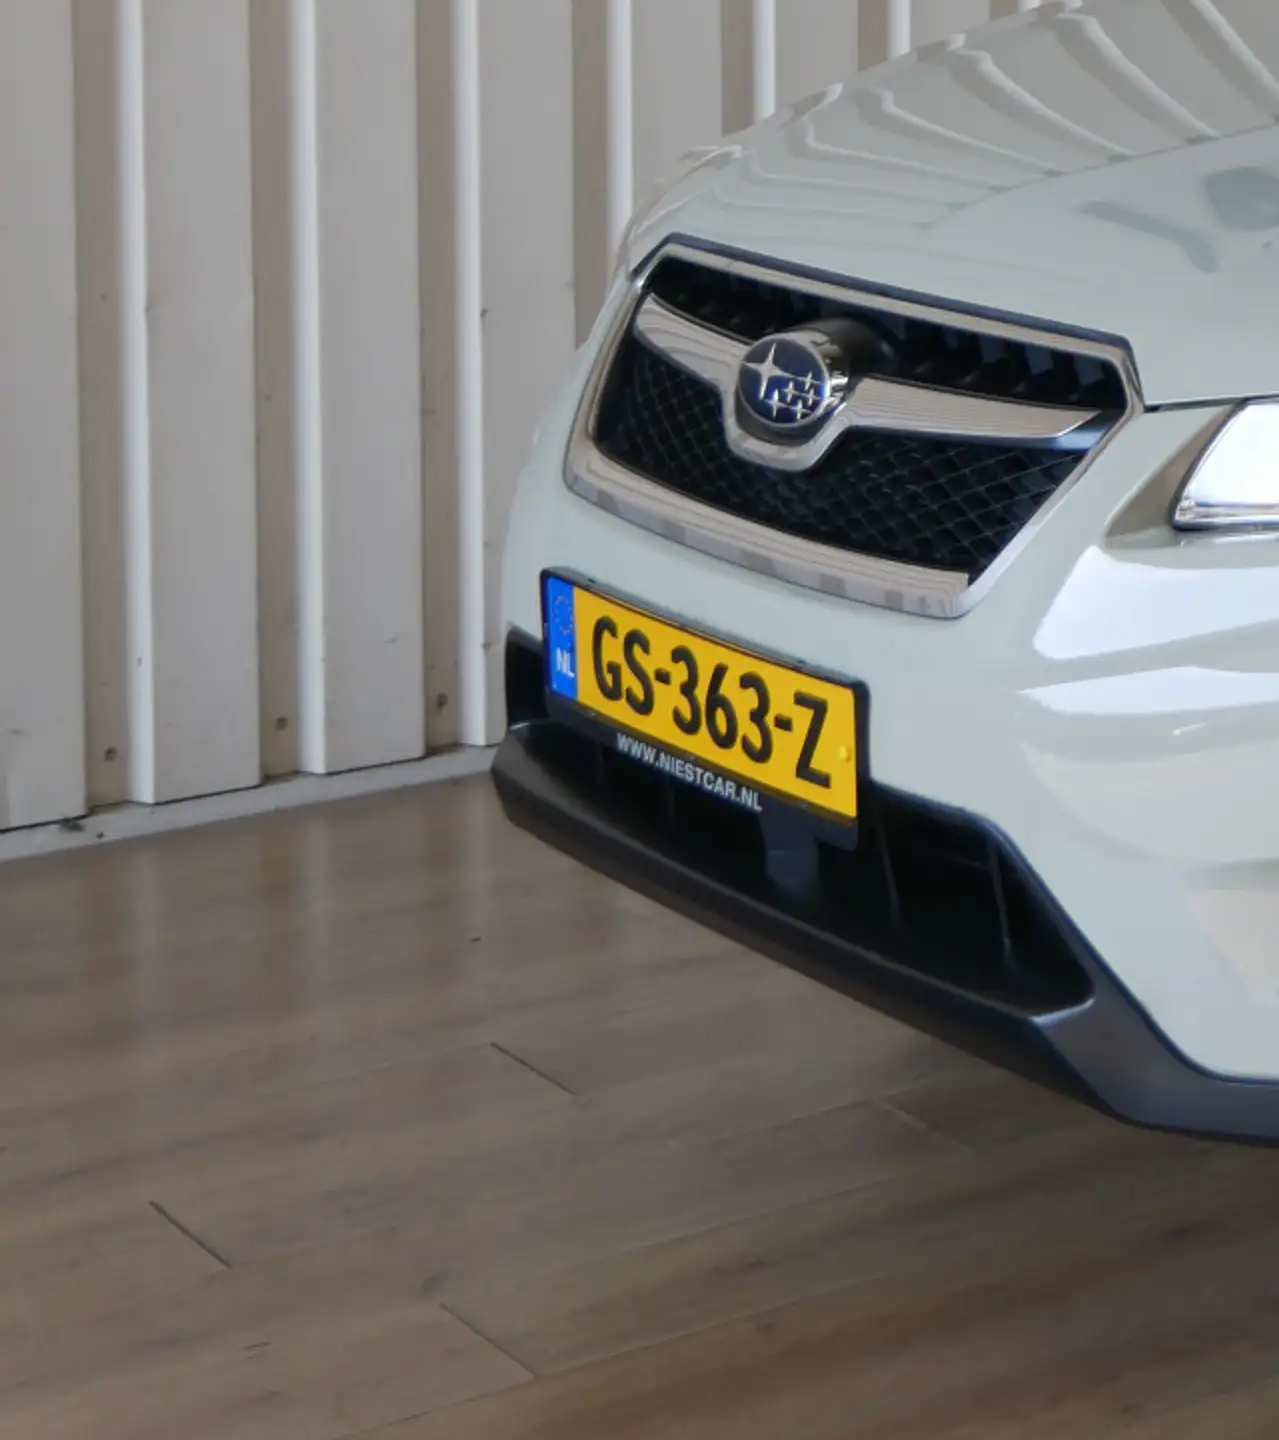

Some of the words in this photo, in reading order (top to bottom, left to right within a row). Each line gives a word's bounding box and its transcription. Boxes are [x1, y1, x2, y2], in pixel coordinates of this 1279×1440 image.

[555, 649, 576, 678] NL
[593, 616, 830, 789] GS-363-Z
[616, 733, 763, 812] WWW.NIESTCAR.NL
